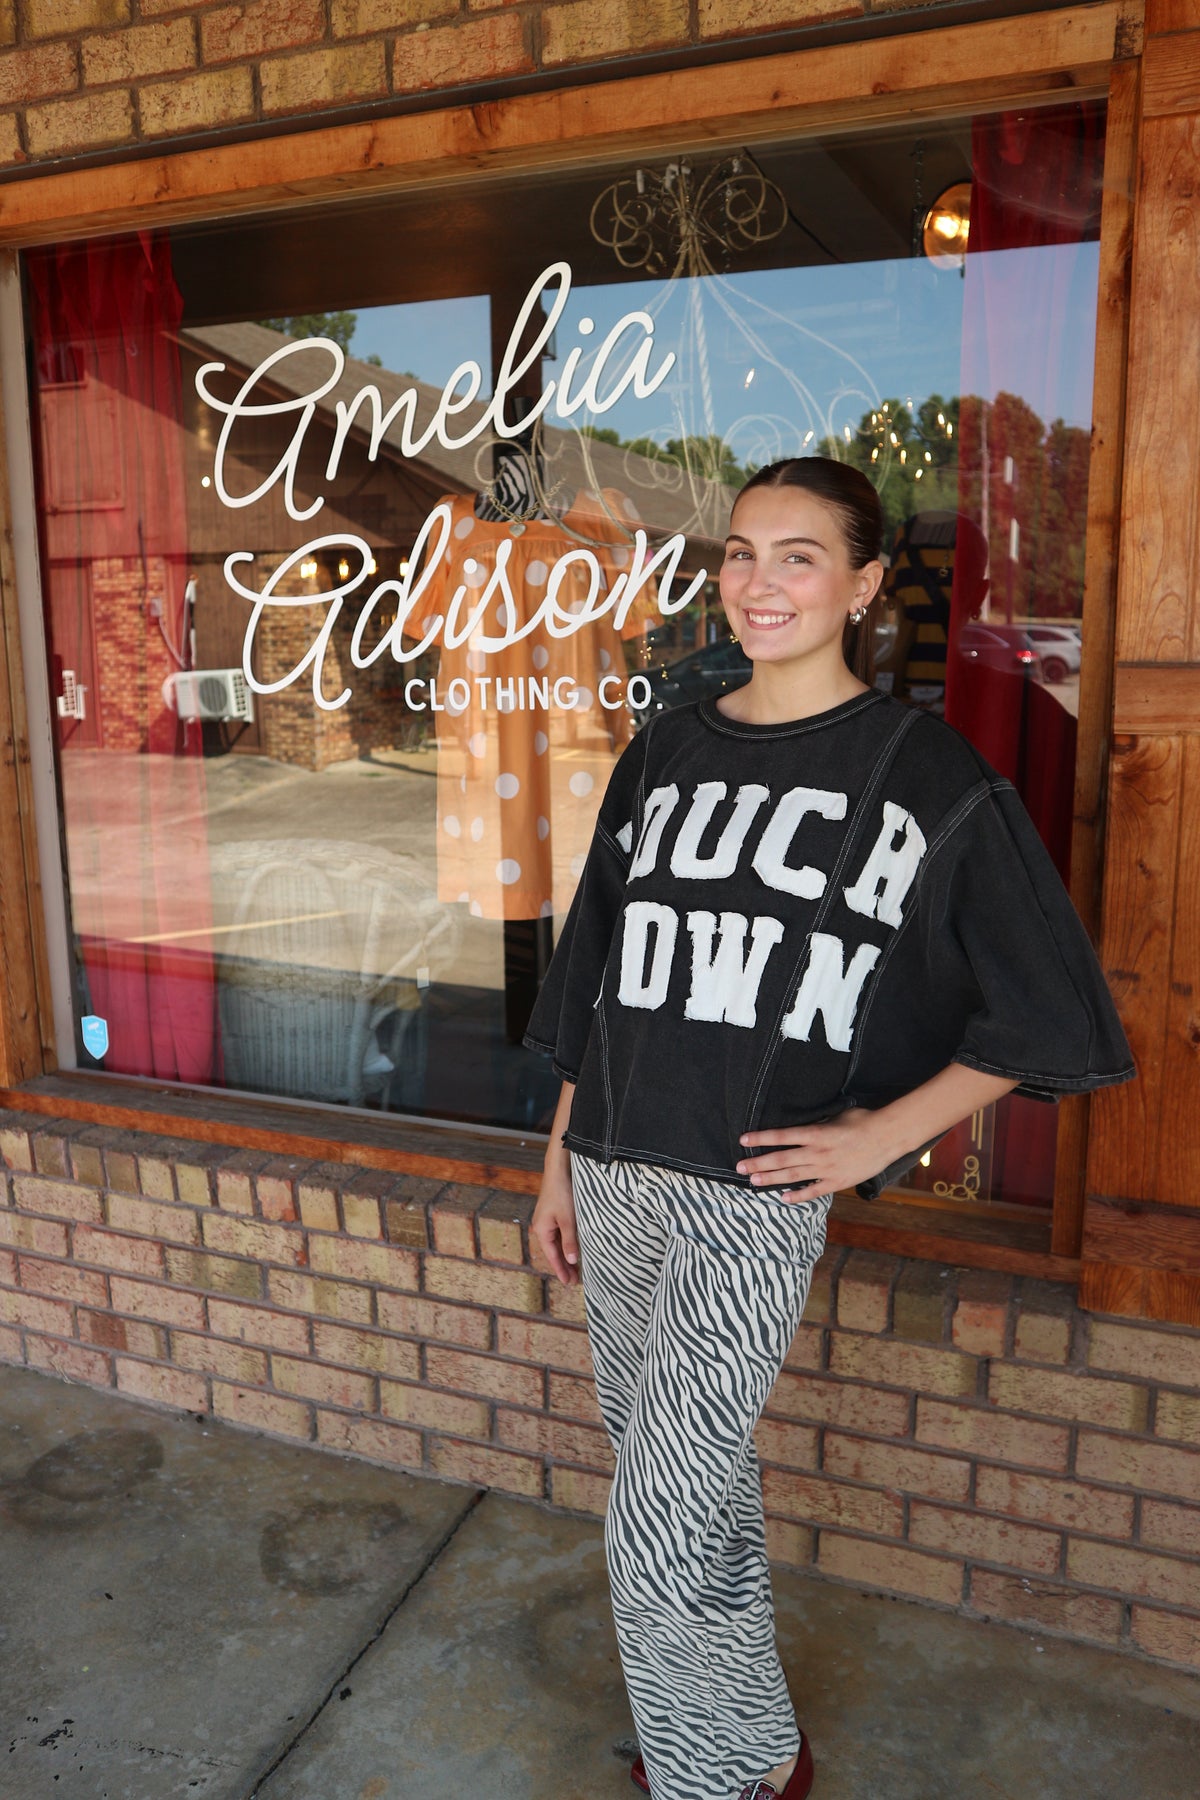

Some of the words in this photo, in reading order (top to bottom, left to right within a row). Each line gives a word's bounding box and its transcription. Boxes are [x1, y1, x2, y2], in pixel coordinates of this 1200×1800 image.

[195, 261, 676, 521] Amelia
[223, 504, 707, 711] Adison
[404, 676, 580, 712] CLOTHING
[597, 675, 665, 711] CO.
